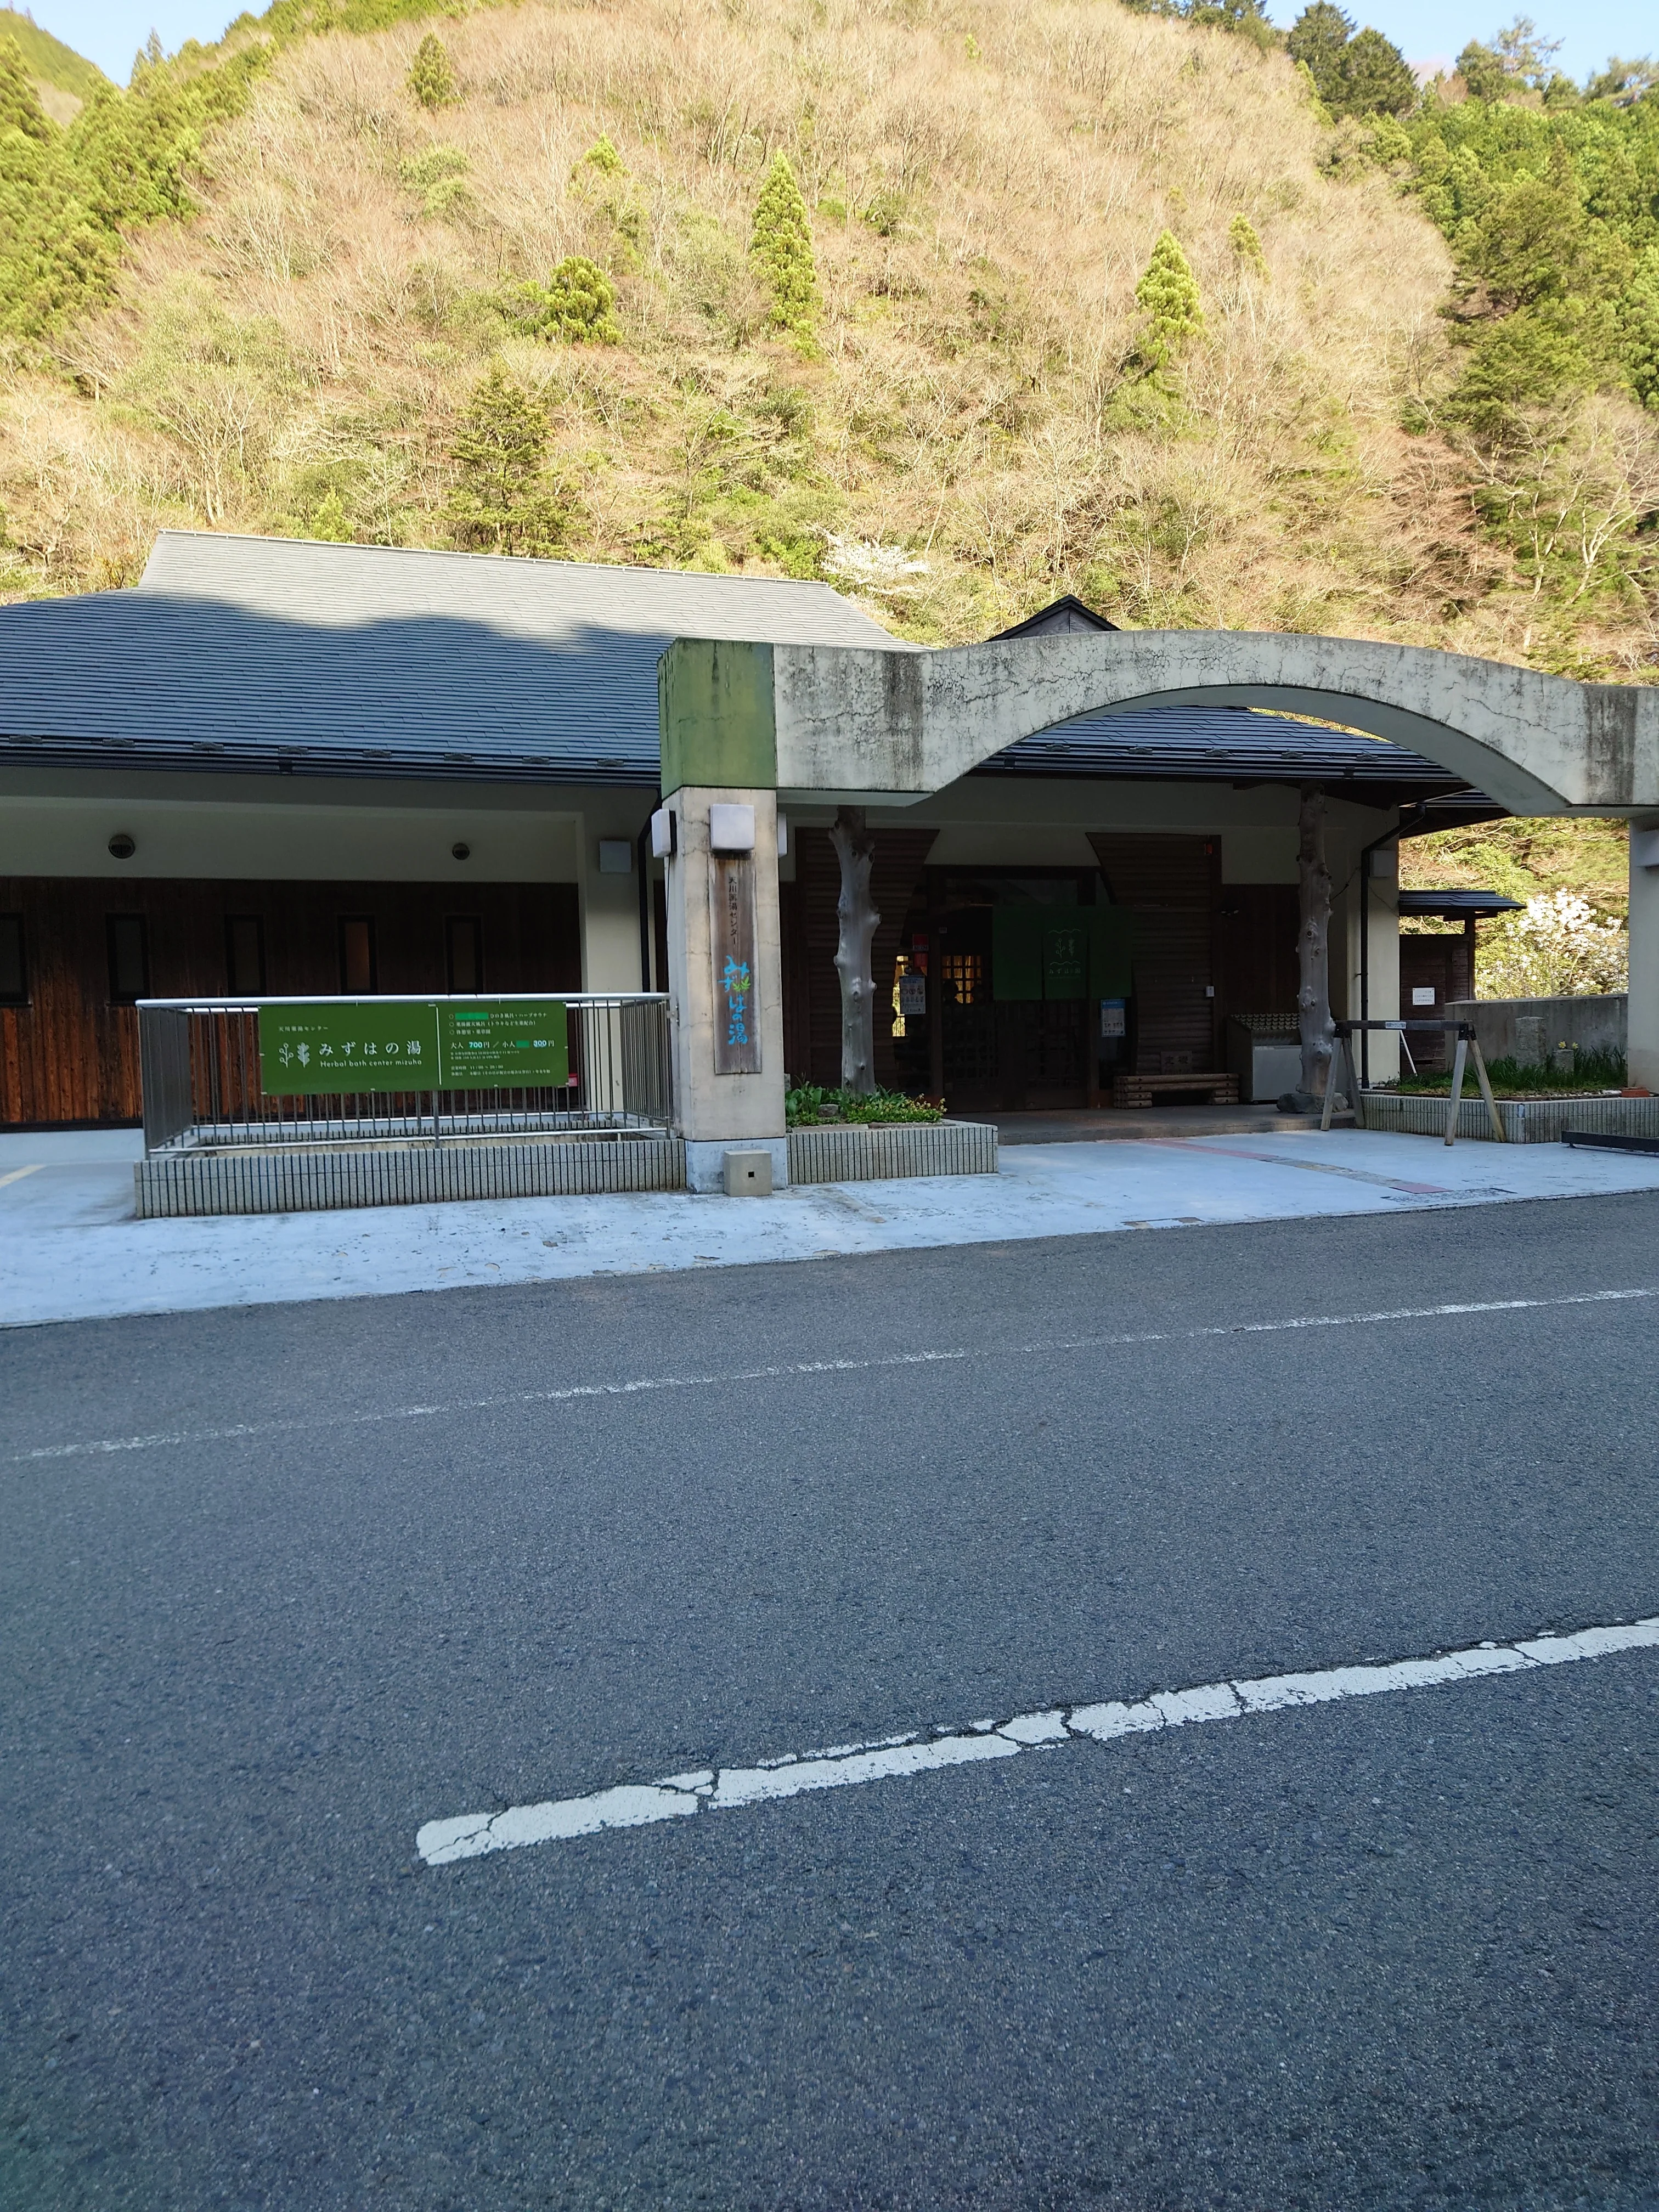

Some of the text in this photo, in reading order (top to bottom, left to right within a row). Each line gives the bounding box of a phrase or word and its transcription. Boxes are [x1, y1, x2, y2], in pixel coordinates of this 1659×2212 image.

[717, 955, 750, 1045] みずはの湯
[319, 1040, 422, 1057] みずはの湯
